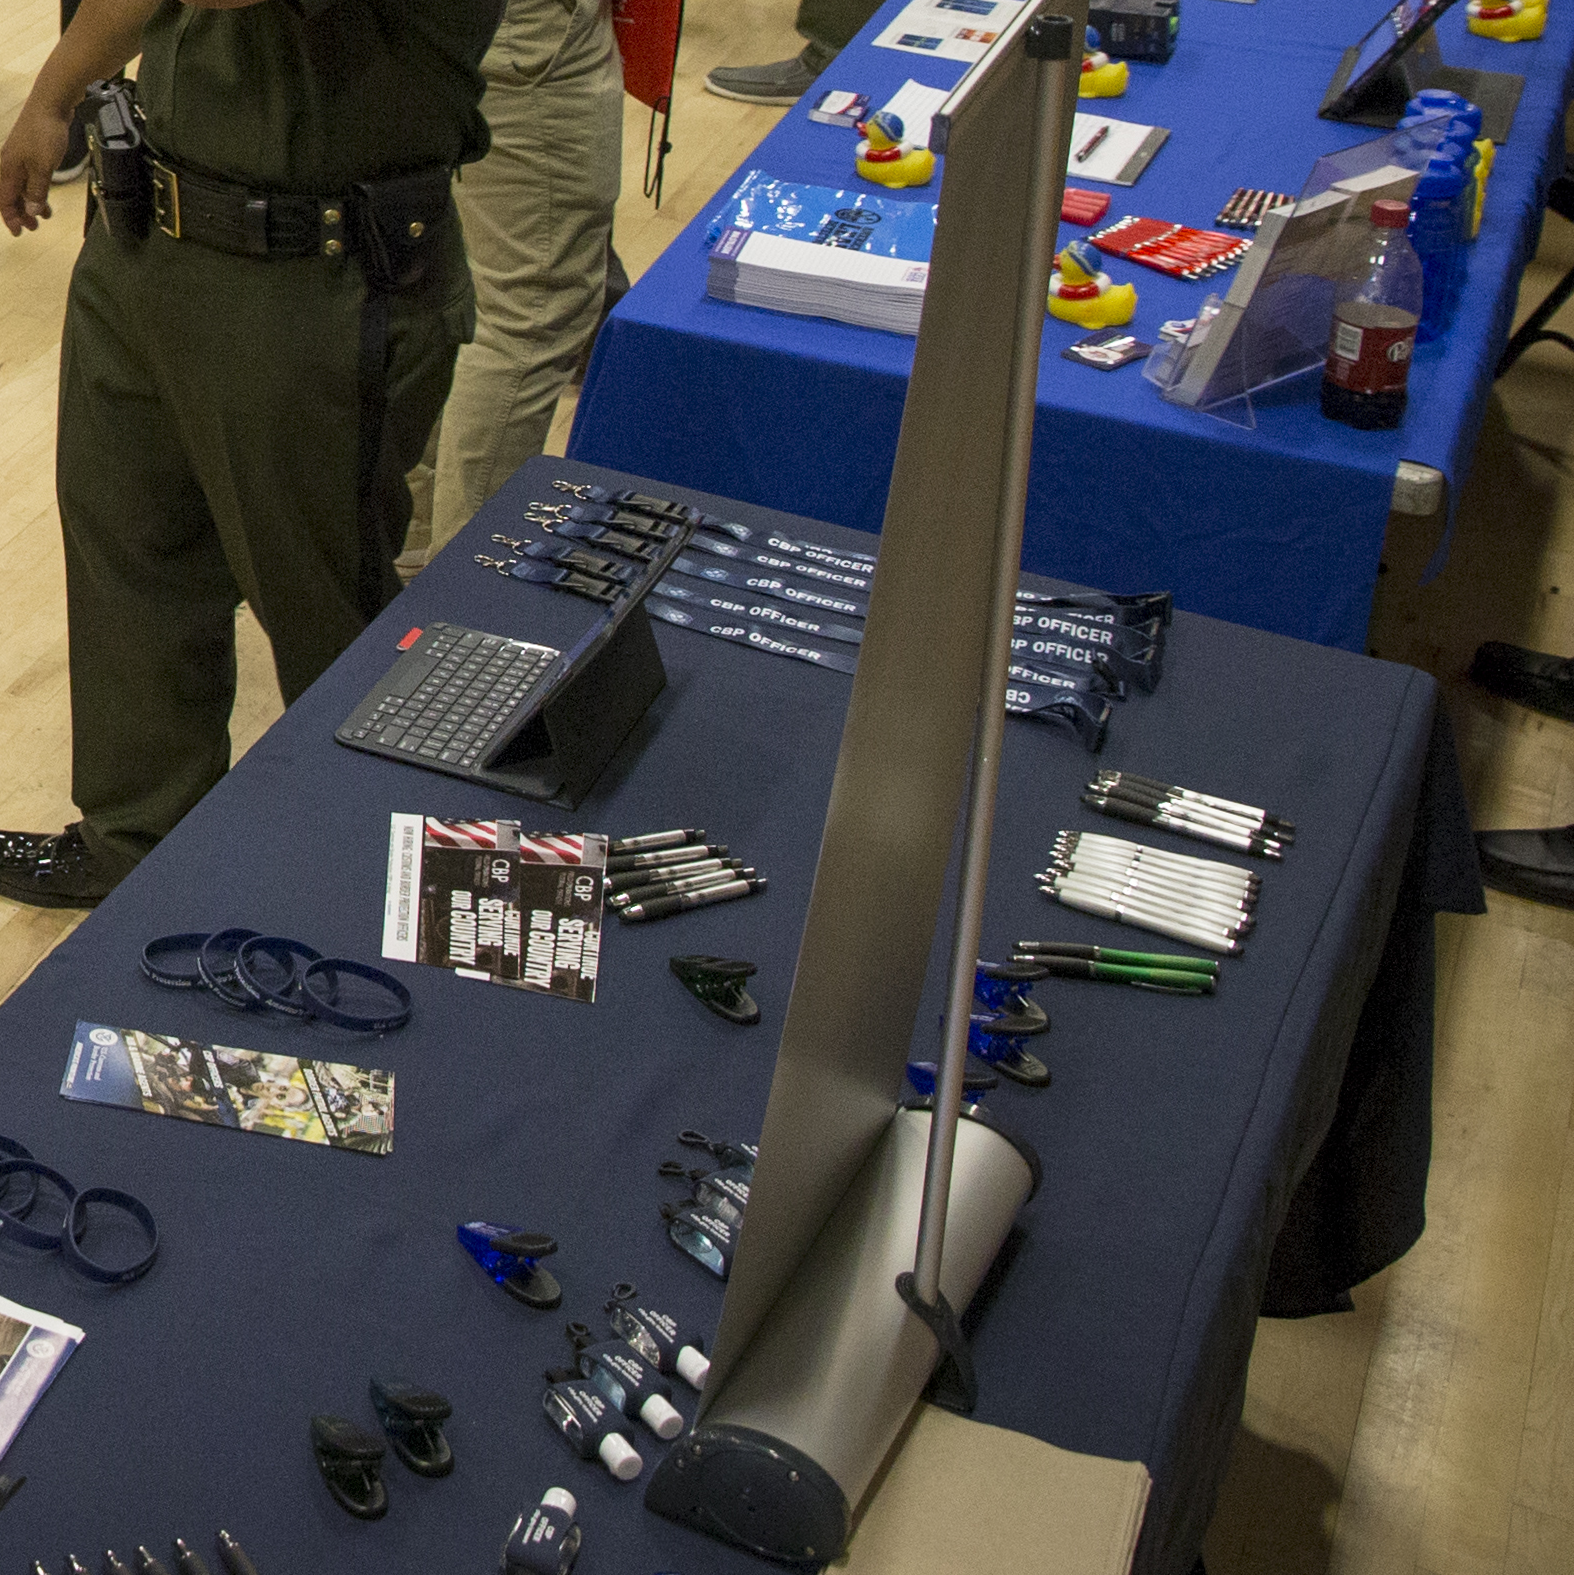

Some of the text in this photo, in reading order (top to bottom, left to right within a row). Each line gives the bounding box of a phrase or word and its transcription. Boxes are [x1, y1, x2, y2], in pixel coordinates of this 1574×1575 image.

[757, 555, 866, 587] CBP OFFICER
[768, 538, 874, 573] CBP OFFICER
[747, 578, 856, 612] CBP OFFICER
[710, 599, 820, 632] CBP OFFICER
[1013, 615, 1033, 626] BP
[1038, 617, 1113, 645] OFFICER
[710, 626, 821, 660] CBP OFFICER
[1008, 666, 1076, 689] FFICER
[491, 859, 510, 883] CBP
[574, 876, 594, 902] CBP
[449, 889, 477, 965] OUR COUNTRY
[477, 897, 504, 947] SERVING
[524, 909, 556, 989] OUR COUNTRY
[554, 918, 584, 970] SERVING
[581, 929, 599, 980] CONTINUE
